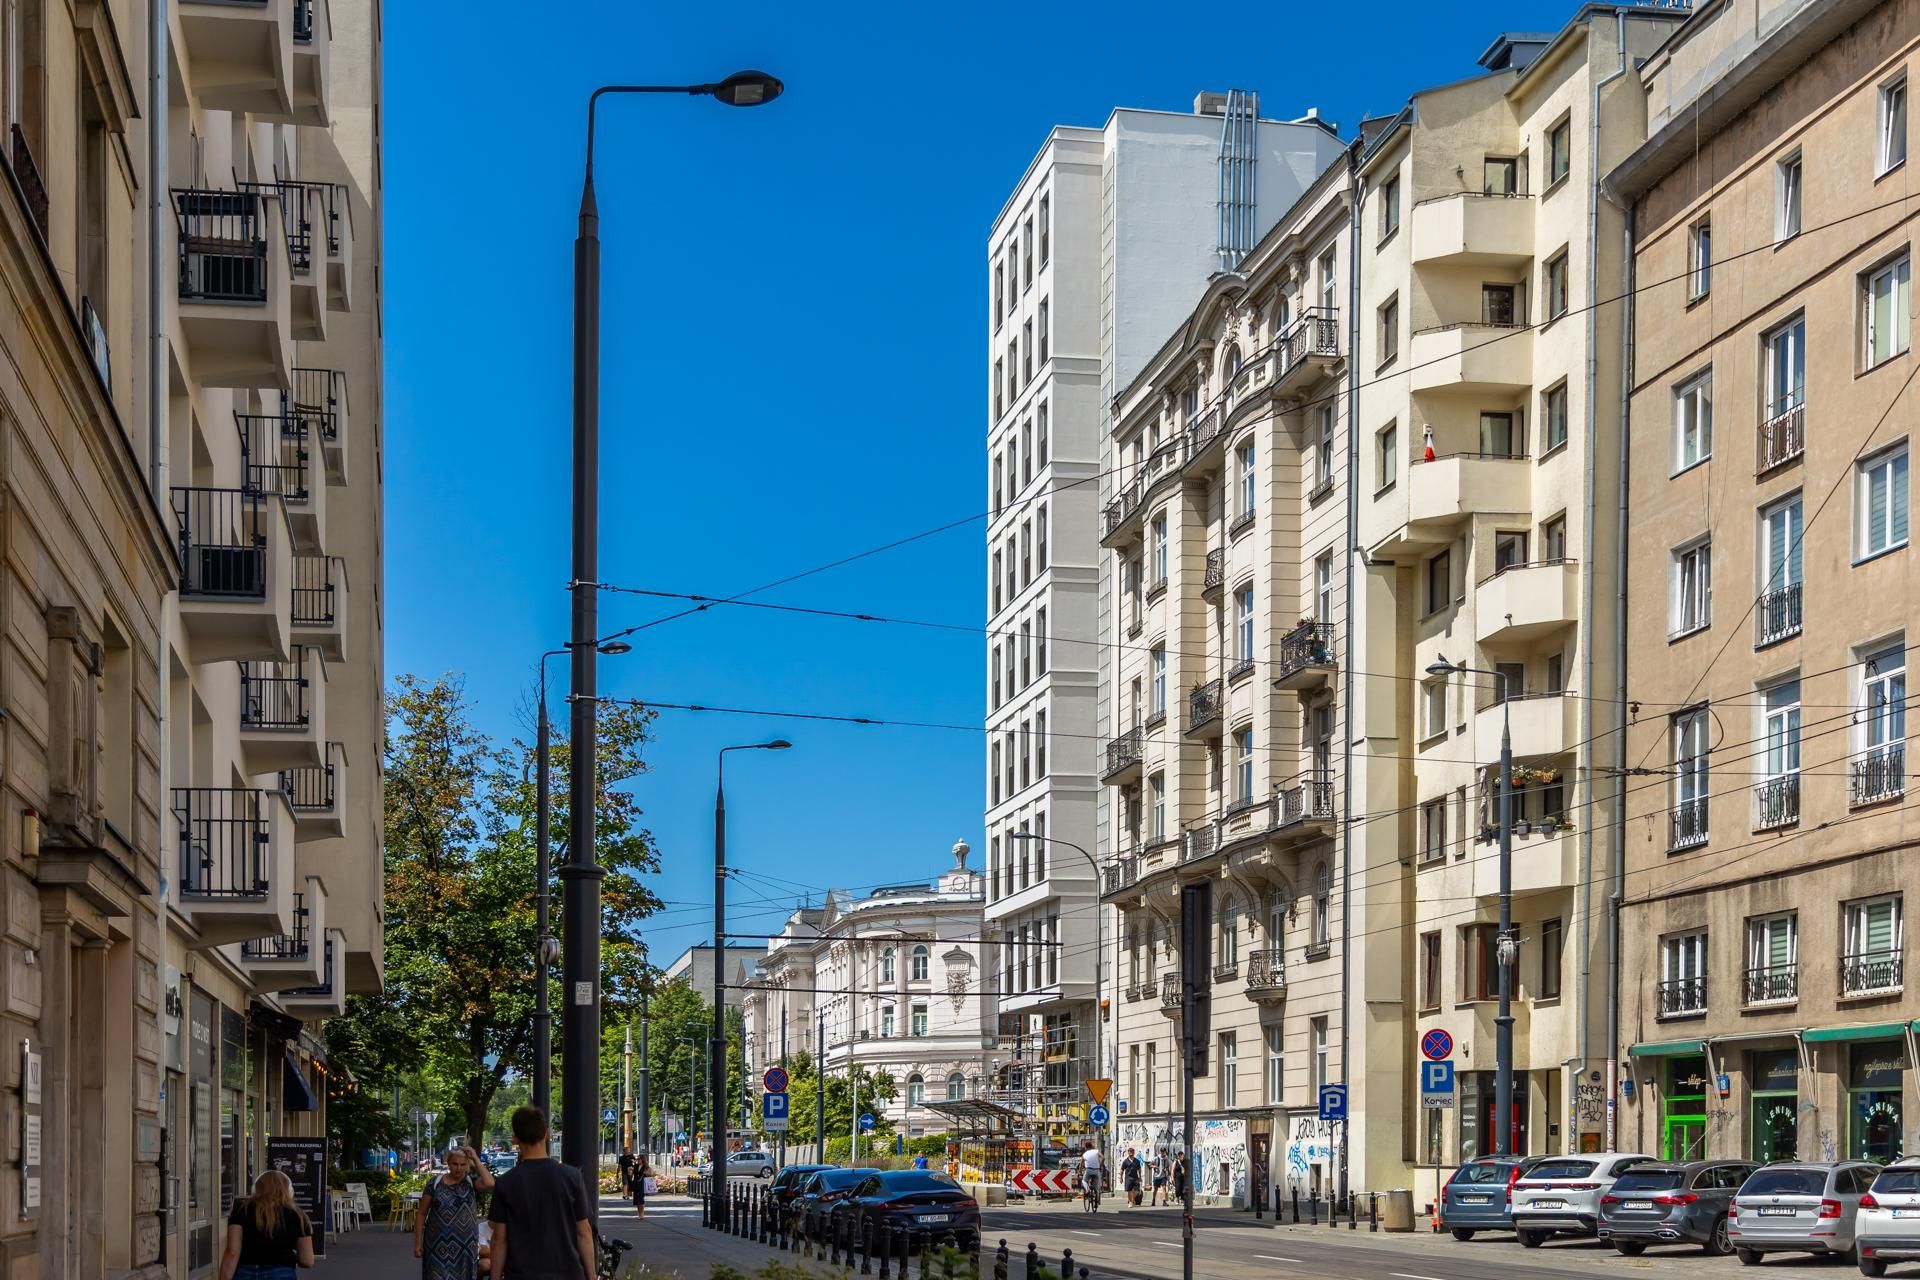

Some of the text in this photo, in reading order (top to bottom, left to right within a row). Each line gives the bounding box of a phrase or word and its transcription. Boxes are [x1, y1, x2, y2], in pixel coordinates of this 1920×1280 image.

[1429, 1064, 1447, 1089] P
[769, 1095, 784, 1115] P
[1325, 1094, 1341, 1113] P
[1424, 1096, 1452, 1105] Koniec
[1765, 1105, 1797, 1126] LENIWA
[1864, 1101, 1899, 1124] LENIWA
